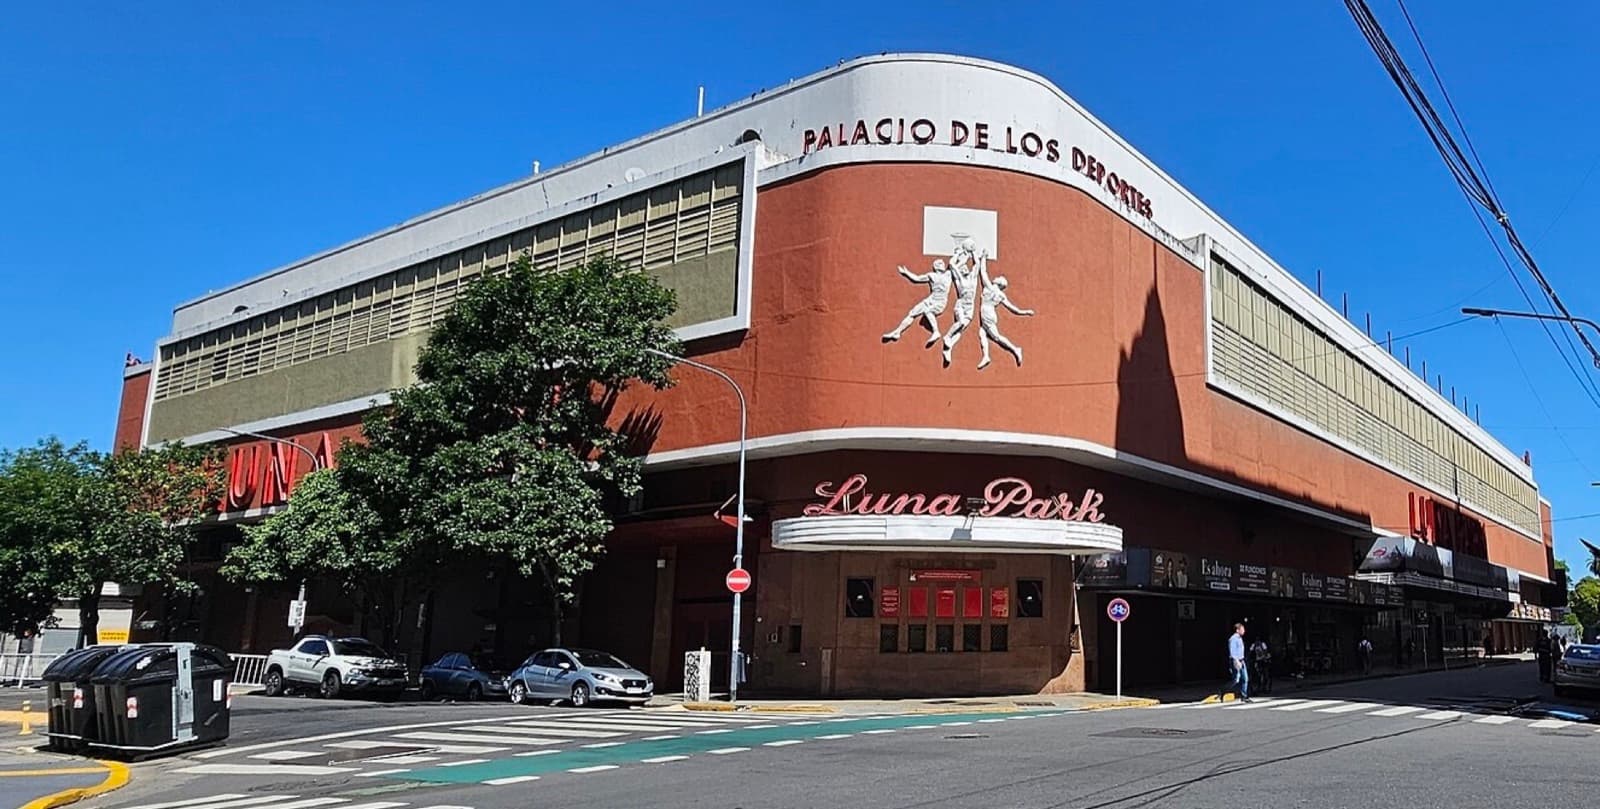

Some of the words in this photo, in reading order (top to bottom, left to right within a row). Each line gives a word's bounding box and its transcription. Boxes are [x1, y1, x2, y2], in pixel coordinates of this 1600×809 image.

[803, 118, 935, 153] PALACIO
[951, 120, 989, 149] DE
[1005, 127, 1060, 163] LOS
[1071, 146, 1154, 219] DEPORTES
[216, 432, 334, 511] UNA
[803, 473, 961, 516] Luna
[979, 477, 1105, 523] Park
